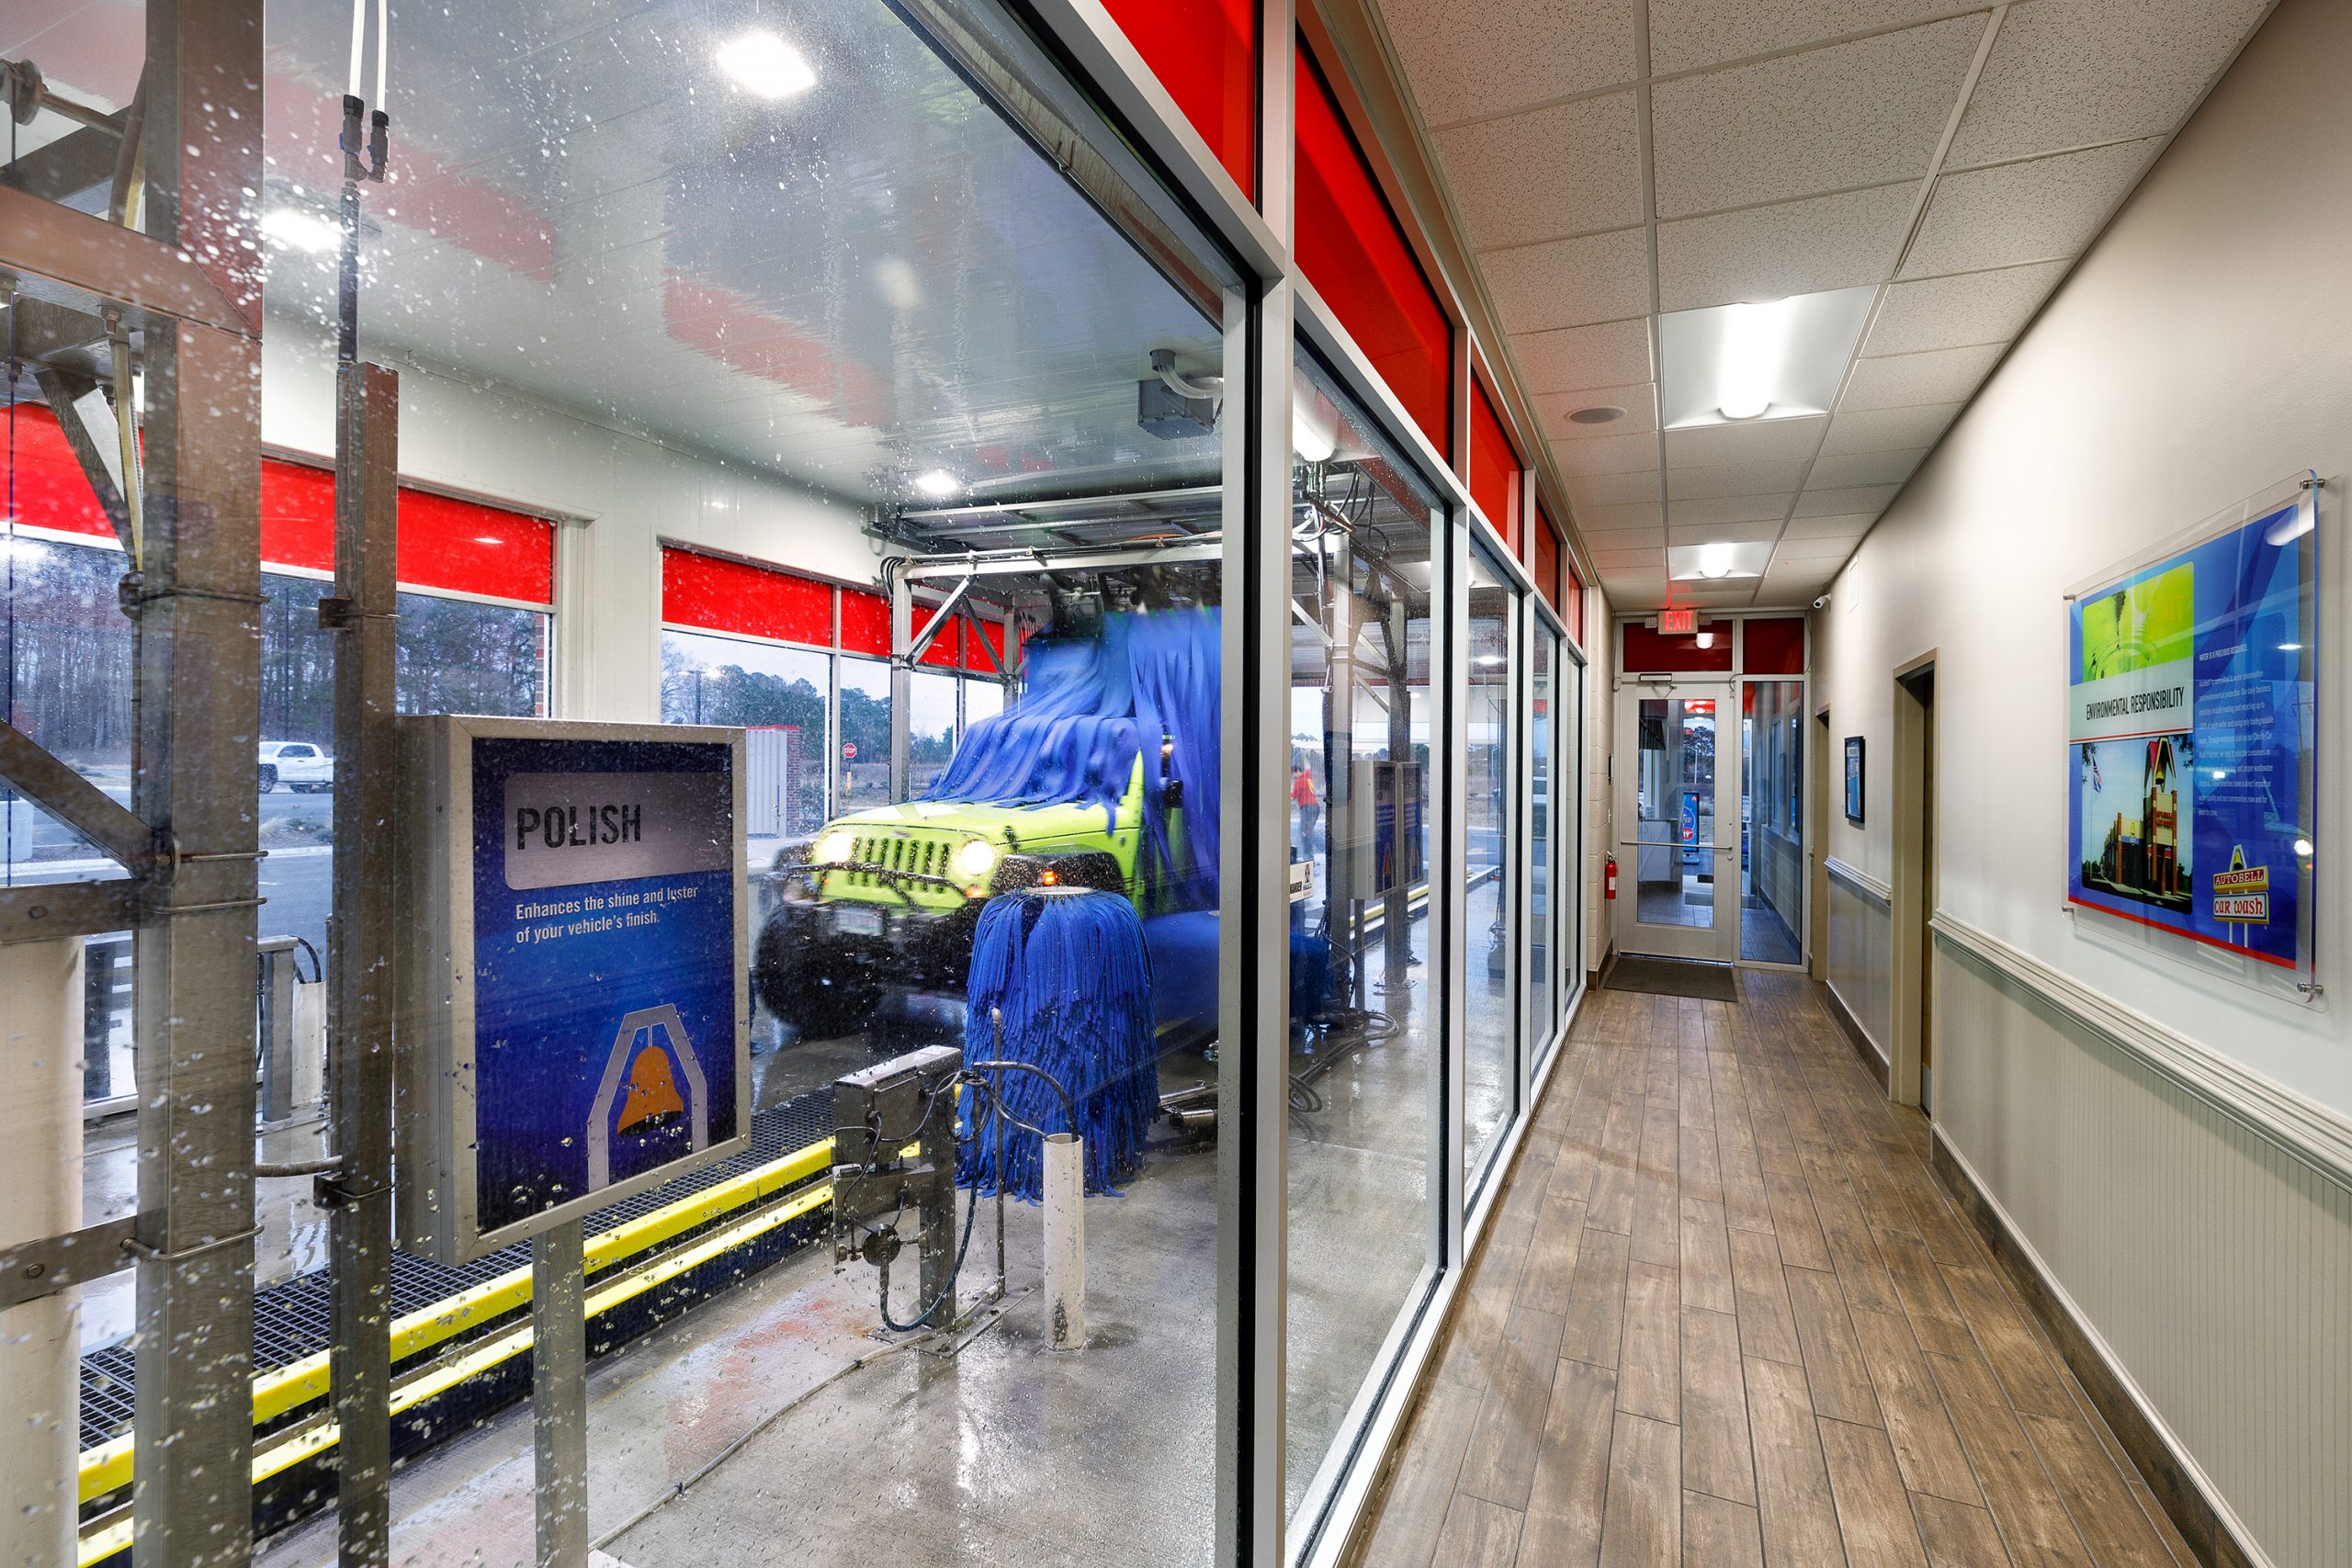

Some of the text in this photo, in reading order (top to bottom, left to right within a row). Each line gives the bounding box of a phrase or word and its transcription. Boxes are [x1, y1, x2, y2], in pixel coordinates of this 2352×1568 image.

[1665, 610, 1693, 631] EXIT
[2086, 696, 2130, 720] ENVIRONMENTAL
[2131, 686, 2185, 714] RESPONSIBILITY
[517, 804, 641, 851] POLISH
[2215, 870, 2264, 886] AUTOBELL
[515, 886, 698, 920] Enhances the shine and luster
[515, 909, 661, 944] of your vehicle's finish.
